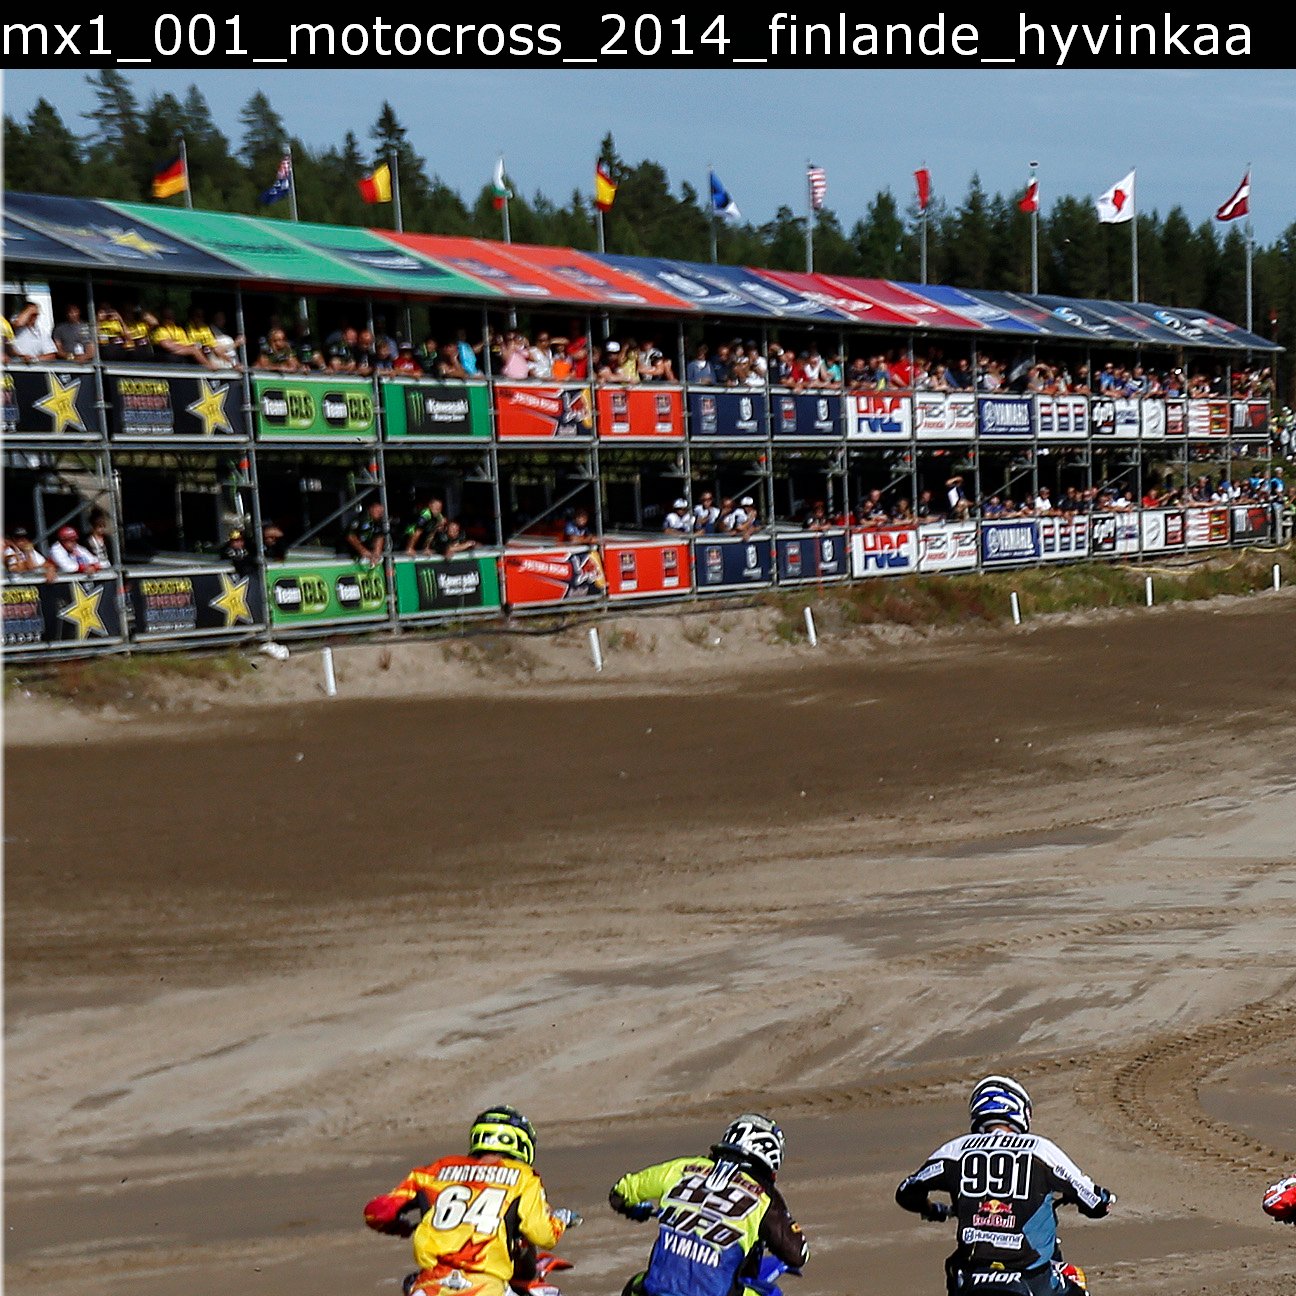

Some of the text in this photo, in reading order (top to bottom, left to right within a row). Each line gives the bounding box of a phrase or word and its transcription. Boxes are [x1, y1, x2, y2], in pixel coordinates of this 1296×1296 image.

[963, 1152, 1030, 1199] 991
[433, 1185, 507, 1236] 64
[664, 1231, 721, 1268] YAMAHA
[972, 1271, 1021, 1284] THOR
